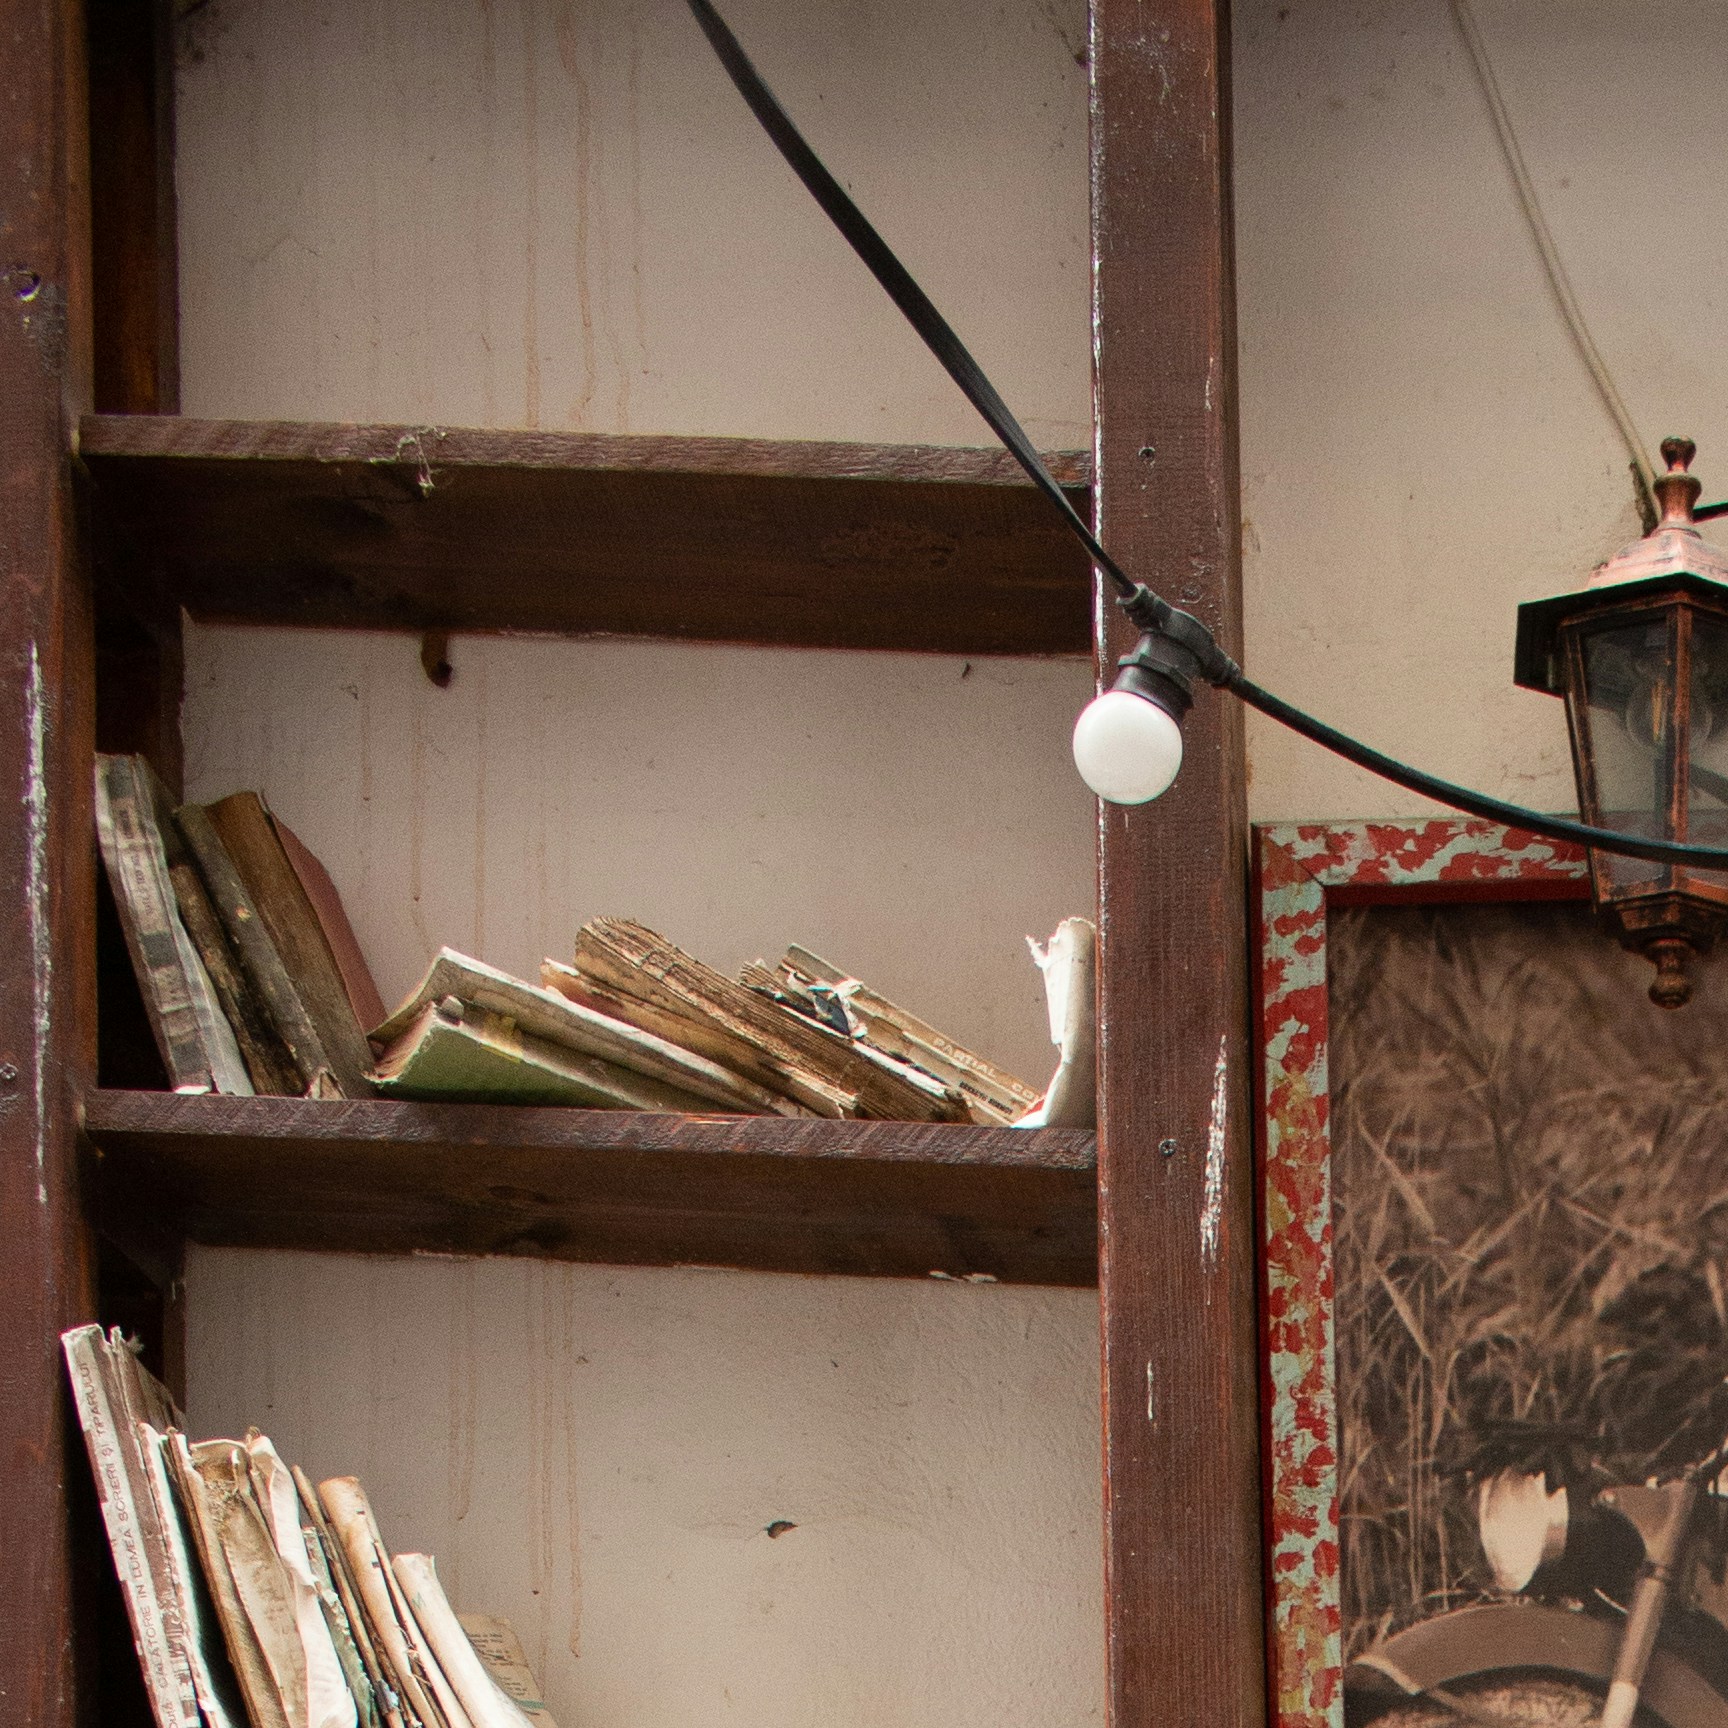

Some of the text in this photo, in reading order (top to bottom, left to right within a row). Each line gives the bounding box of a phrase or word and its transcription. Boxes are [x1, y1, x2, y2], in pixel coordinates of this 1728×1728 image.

[80, 1361, 106, 1437] TIPARULUI
[107, 1461, 128, 1521] SCRIERII
[121, 1529, 142, 1578] LUMEA
